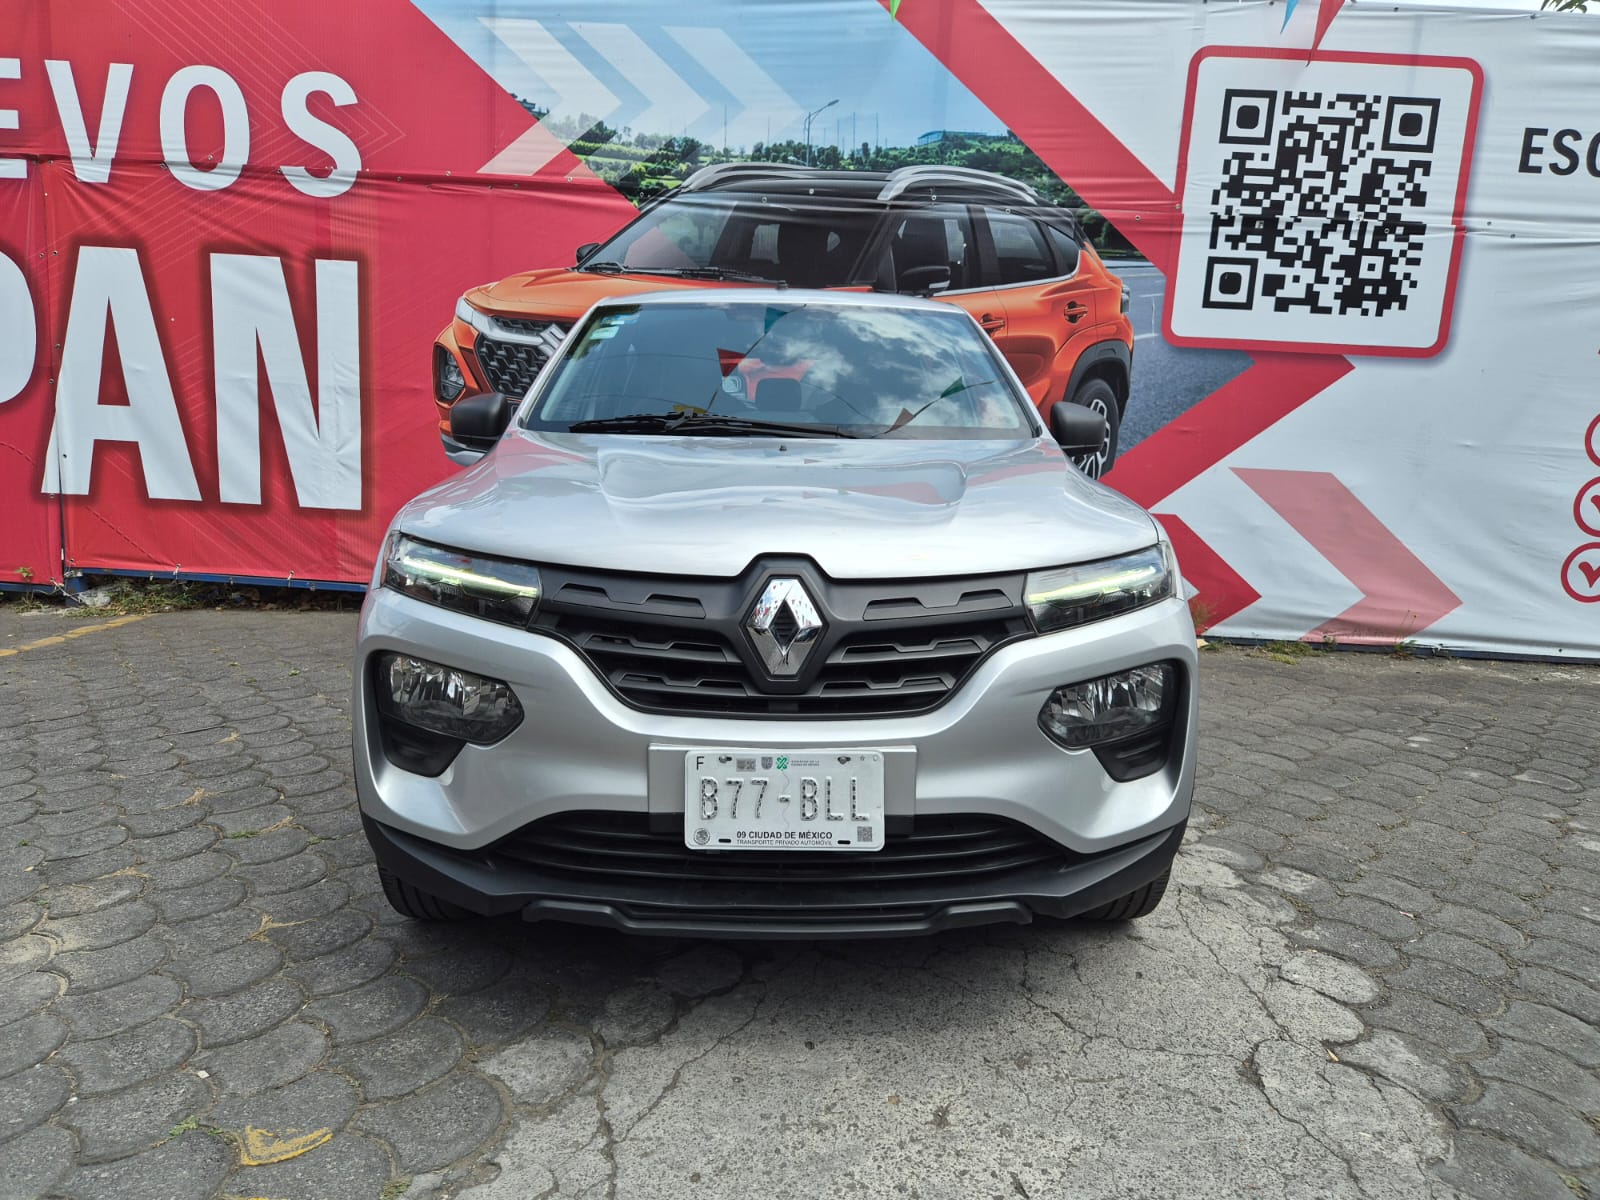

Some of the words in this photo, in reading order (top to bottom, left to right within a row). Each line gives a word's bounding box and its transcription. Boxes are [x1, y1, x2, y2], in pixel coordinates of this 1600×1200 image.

[0, 243, 362, 511] AN
[696, 756, 705, 770] F
[701, 776, 870, 821] B77-BLL
[736, 831, 747, 839] 09
[748, 831, 783, 839] CIUDAD
[784, 831, 797, 839] DE
[798, 829, 833, 839] MÉXICO
